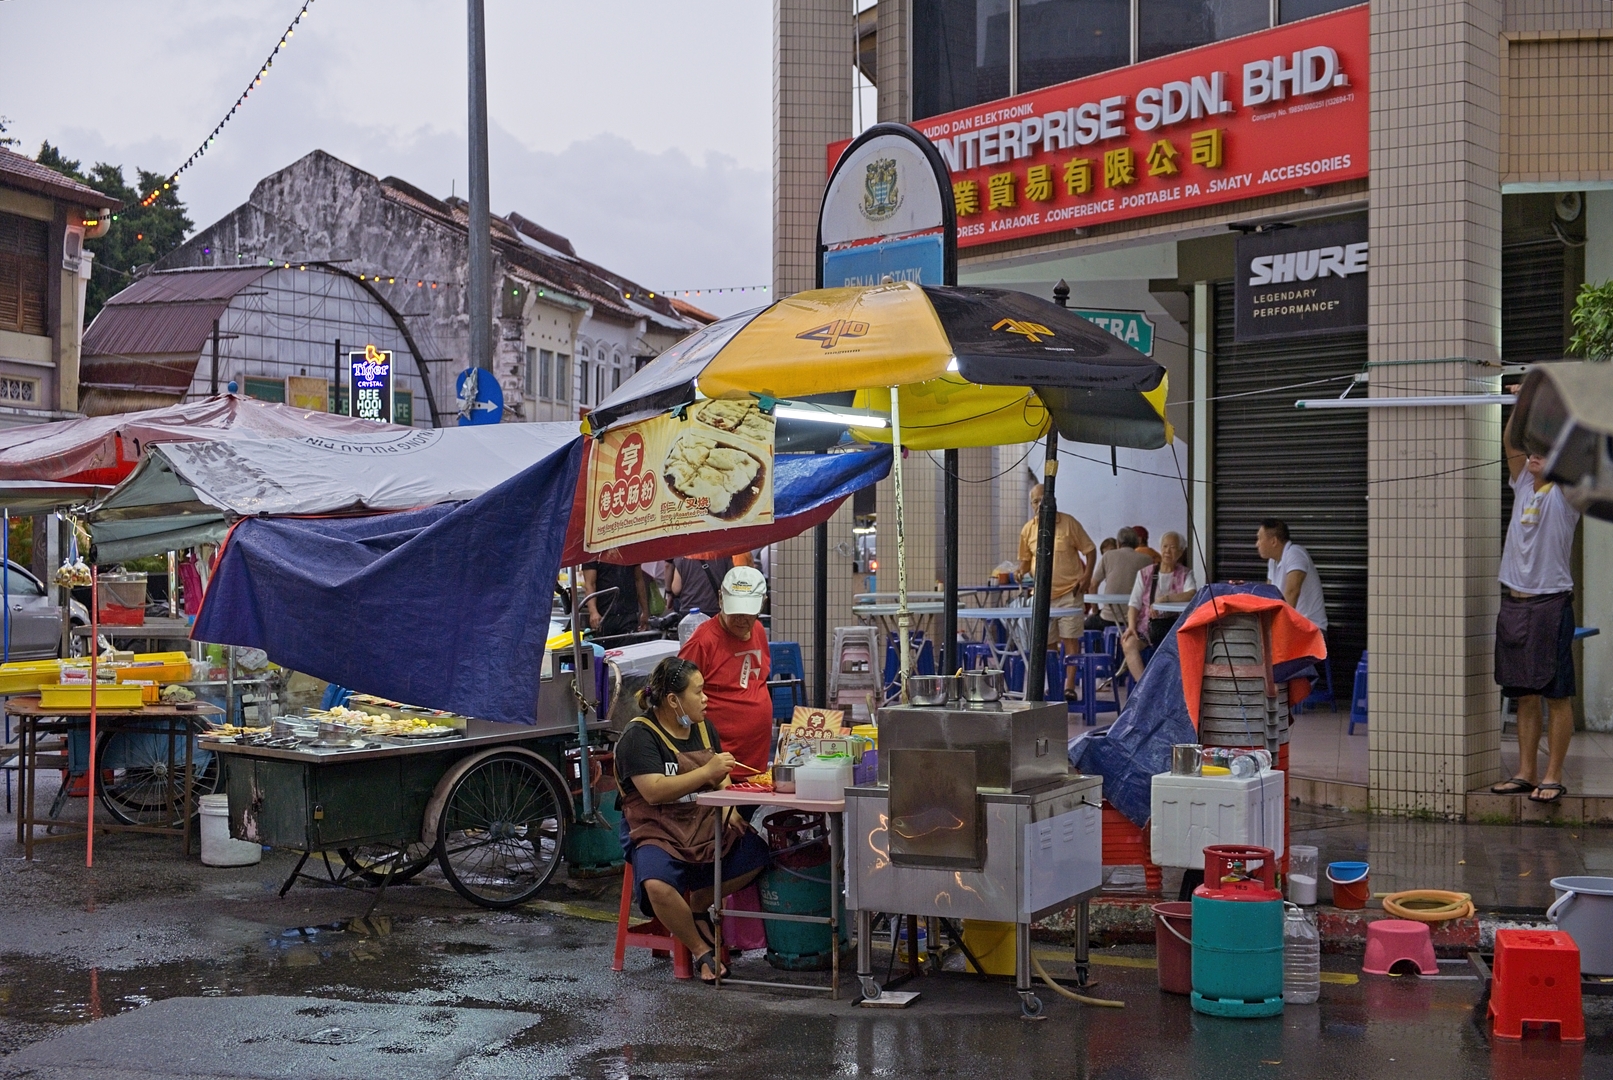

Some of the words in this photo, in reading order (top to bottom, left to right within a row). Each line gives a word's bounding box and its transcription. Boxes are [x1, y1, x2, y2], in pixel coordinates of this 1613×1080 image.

[1134, 71, 1230, 132] SDN.
[1243, 45, 1346, 107] BHD.
[922, 123, 950, 137] AUDIO
[952, 118, 972, 132] DAN
[974, 102, 1034, 127] ELEKTRONIK
[1251, 111, 1277, 122] Company
[1278, 108, 1287, 116] No.
[1185, 183, 1201, 197] PA
[1249, 242, 1367, 286] SHURE
[844, 273, 886, 287] PENJAJ
[1253, 288, 1317, 304] LEGENDARY
[353, 361, 389, 381] Tiger
[358, 389, 380, 400] BEE
[356, 399, 382, 410] HOOI
[359, 409, 379, 418] CAFE
[341, 443, 398, 454] PULAU
